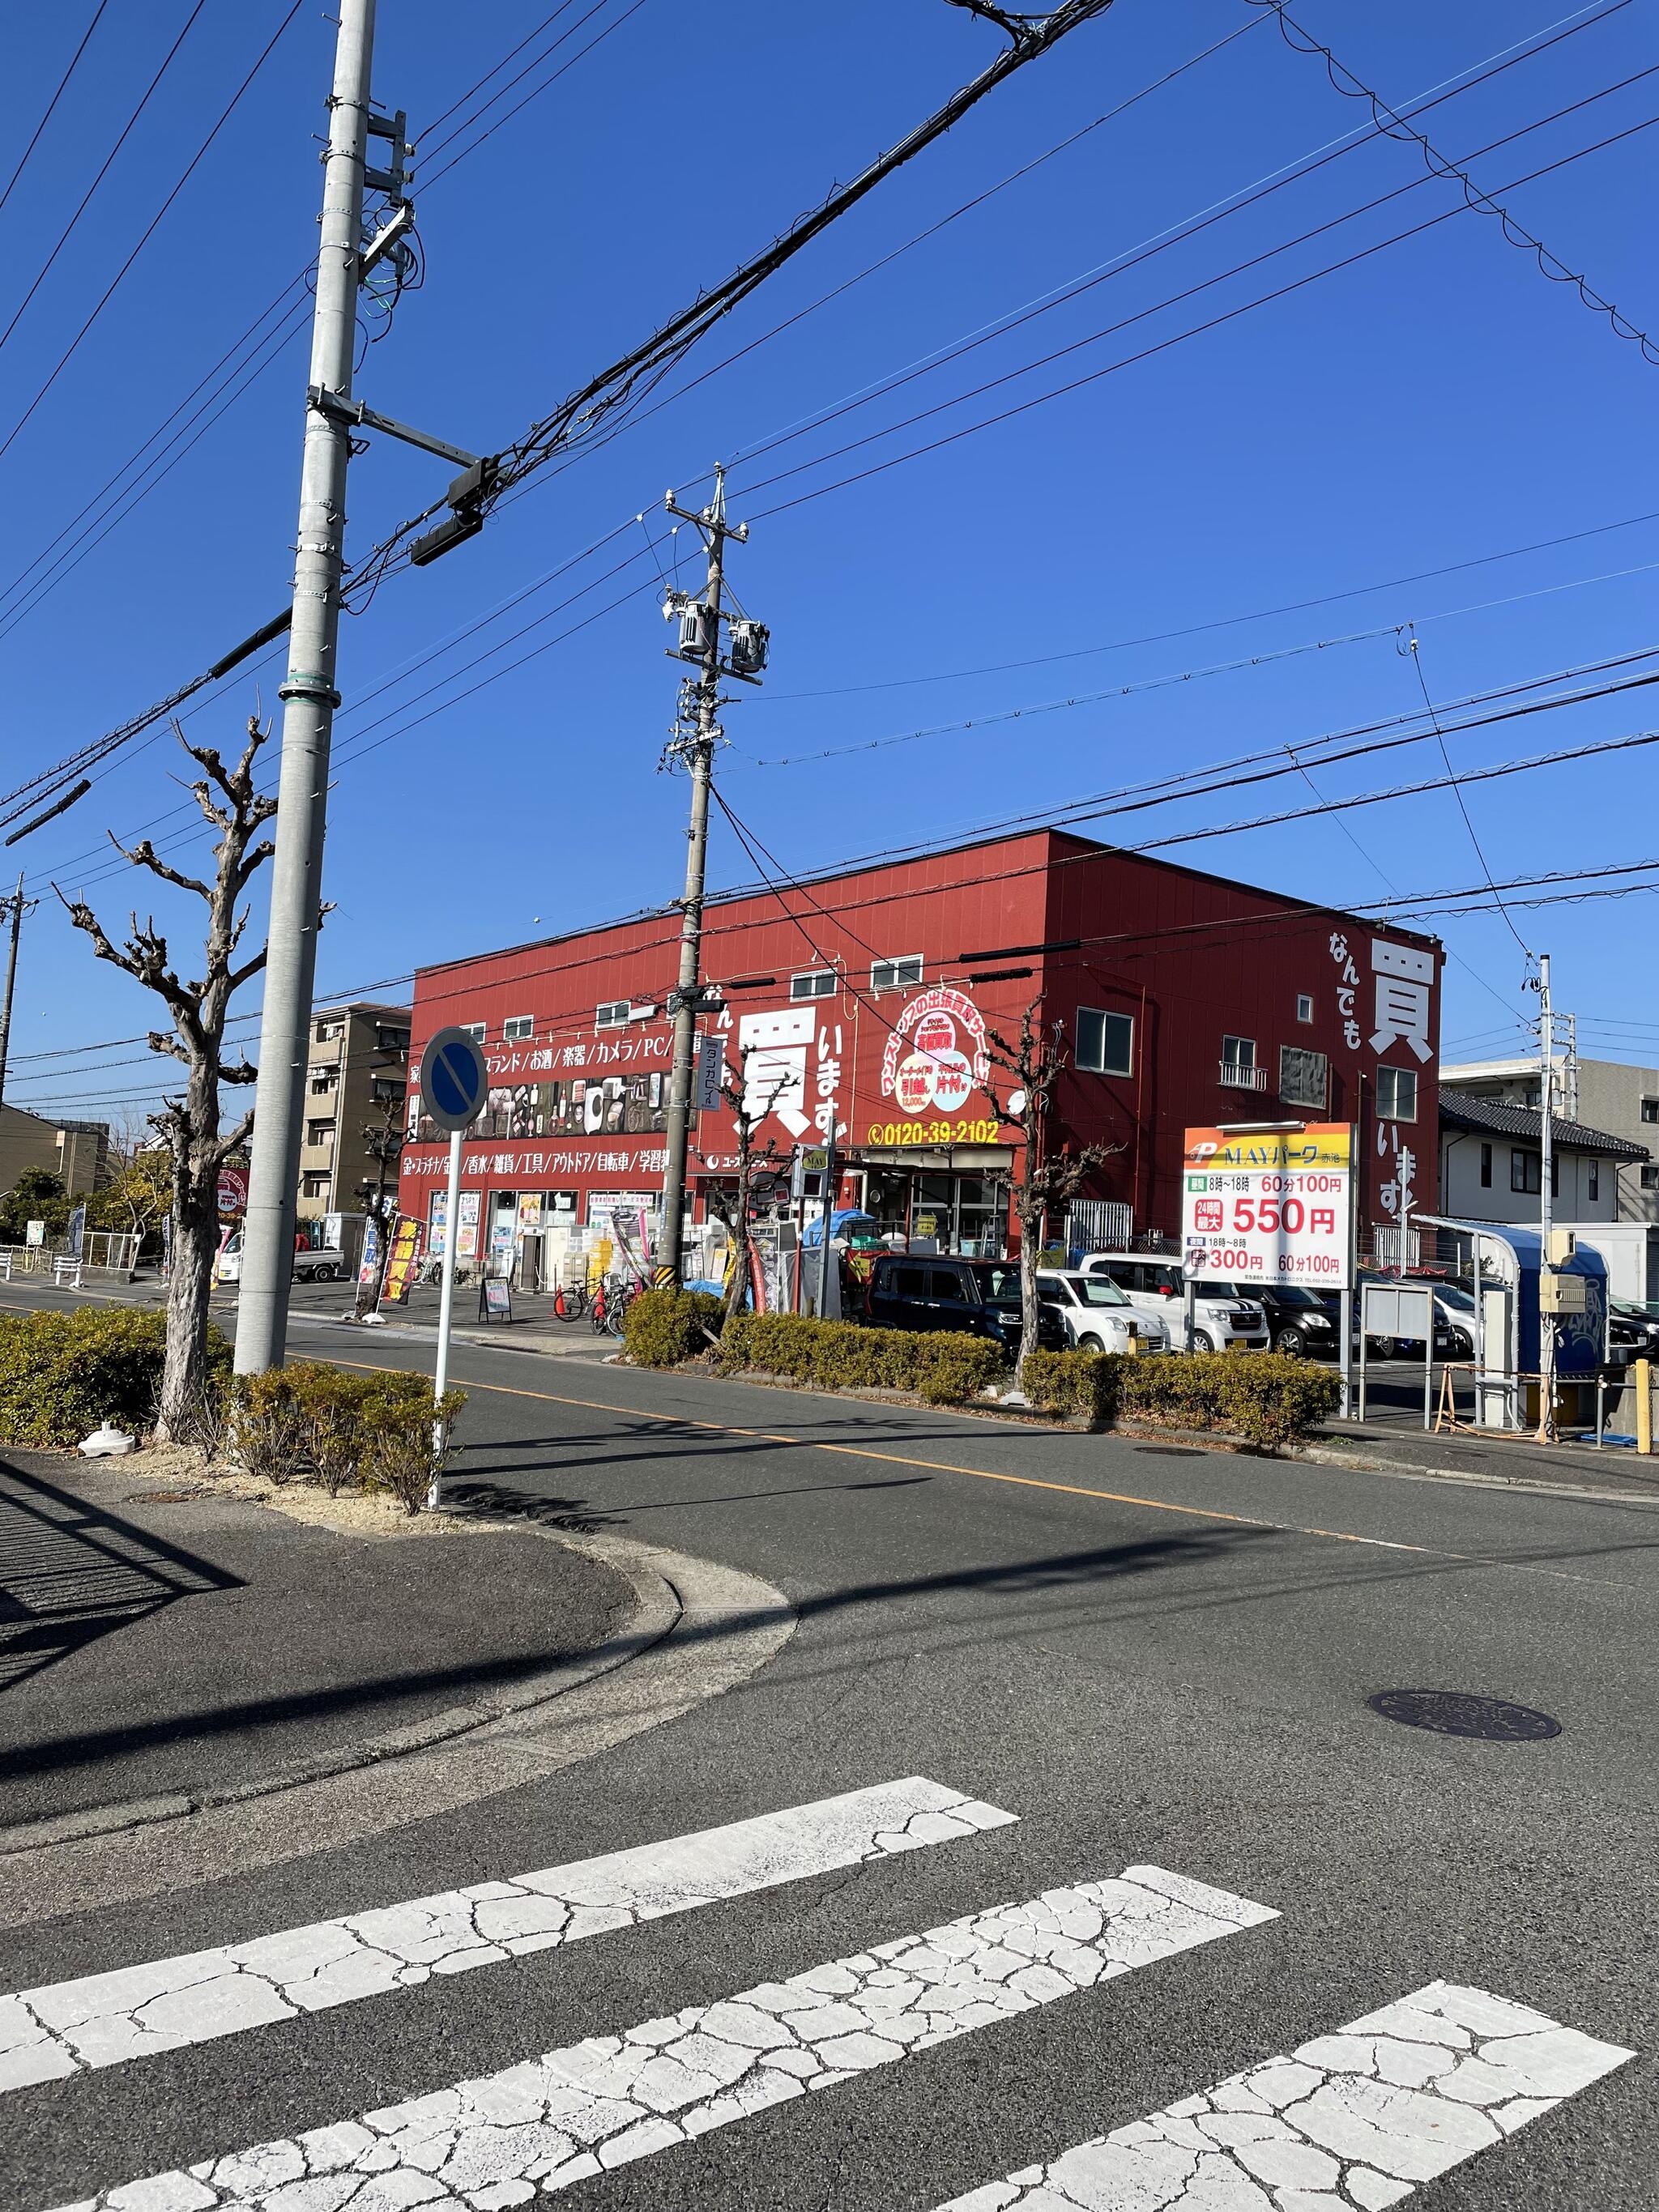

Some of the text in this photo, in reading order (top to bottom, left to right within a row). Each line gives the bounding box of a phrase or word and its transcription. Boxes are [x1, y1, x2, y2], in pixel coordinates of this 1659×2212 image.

[1329, 932, 1362, 1050] なんでも
[1367, 937, 1435, 1063] 買
[732, 1006, 817, 1139] 買
[884, 1119, 1000, 1145] 0120-39-2102
[1261, 1175, 1341, 1193] 60分100円
[1197, 1201, 1221, 1217] 24時間
[1233, 1199, 1335, 1234] 550円
[1197, 1217, 1221, 1230] 最大
[1210, 1248, 1340, 1274] 300円 60分100円
